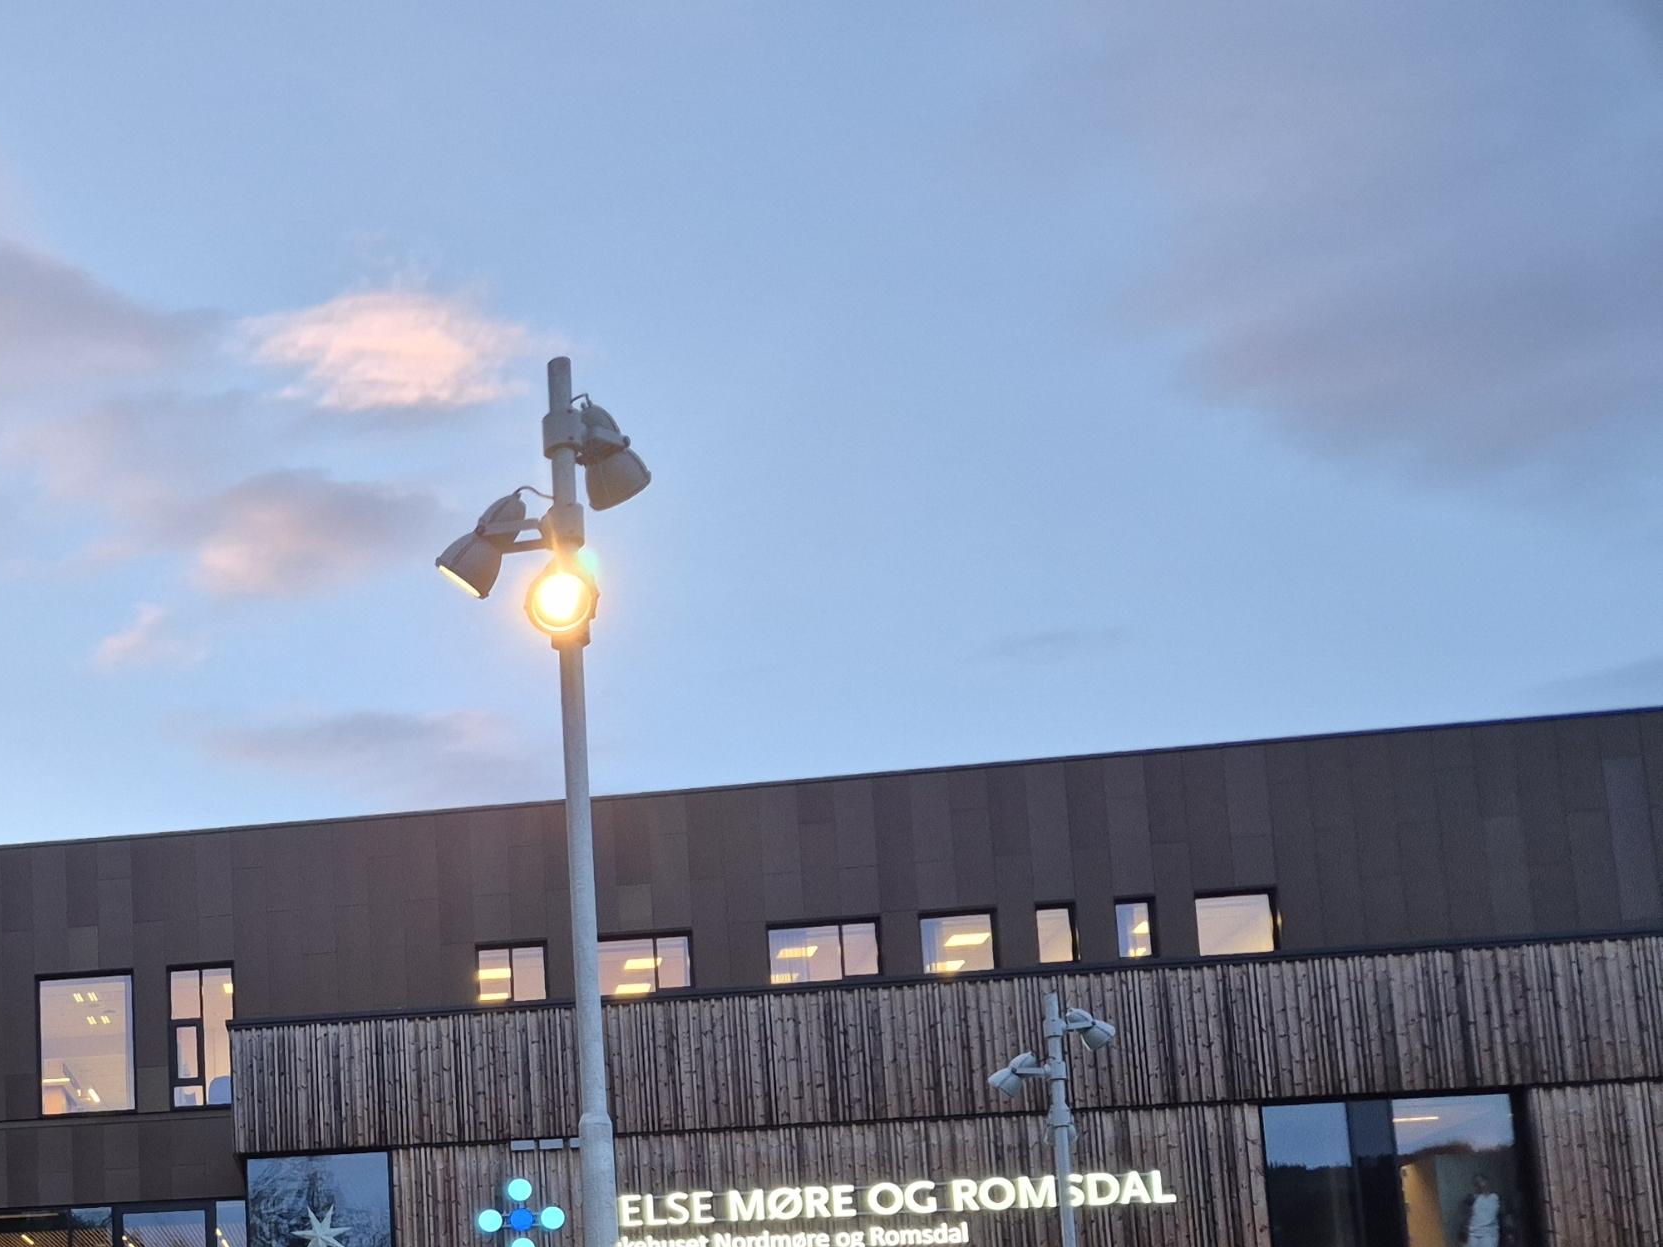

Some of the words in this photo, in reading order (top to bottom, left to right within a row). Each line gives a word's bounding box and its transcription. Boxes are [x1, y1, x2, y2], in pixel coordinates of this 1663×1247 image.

[618, 1190, 716, 1227] ELSE
[727, 1184, 857, 1222] MØRE
[867, 1180, 938, 1216] OG
[951, 1170, 1177, 1212] ROMSDAL
[869, 1221, 970, 1247] Romsdal
